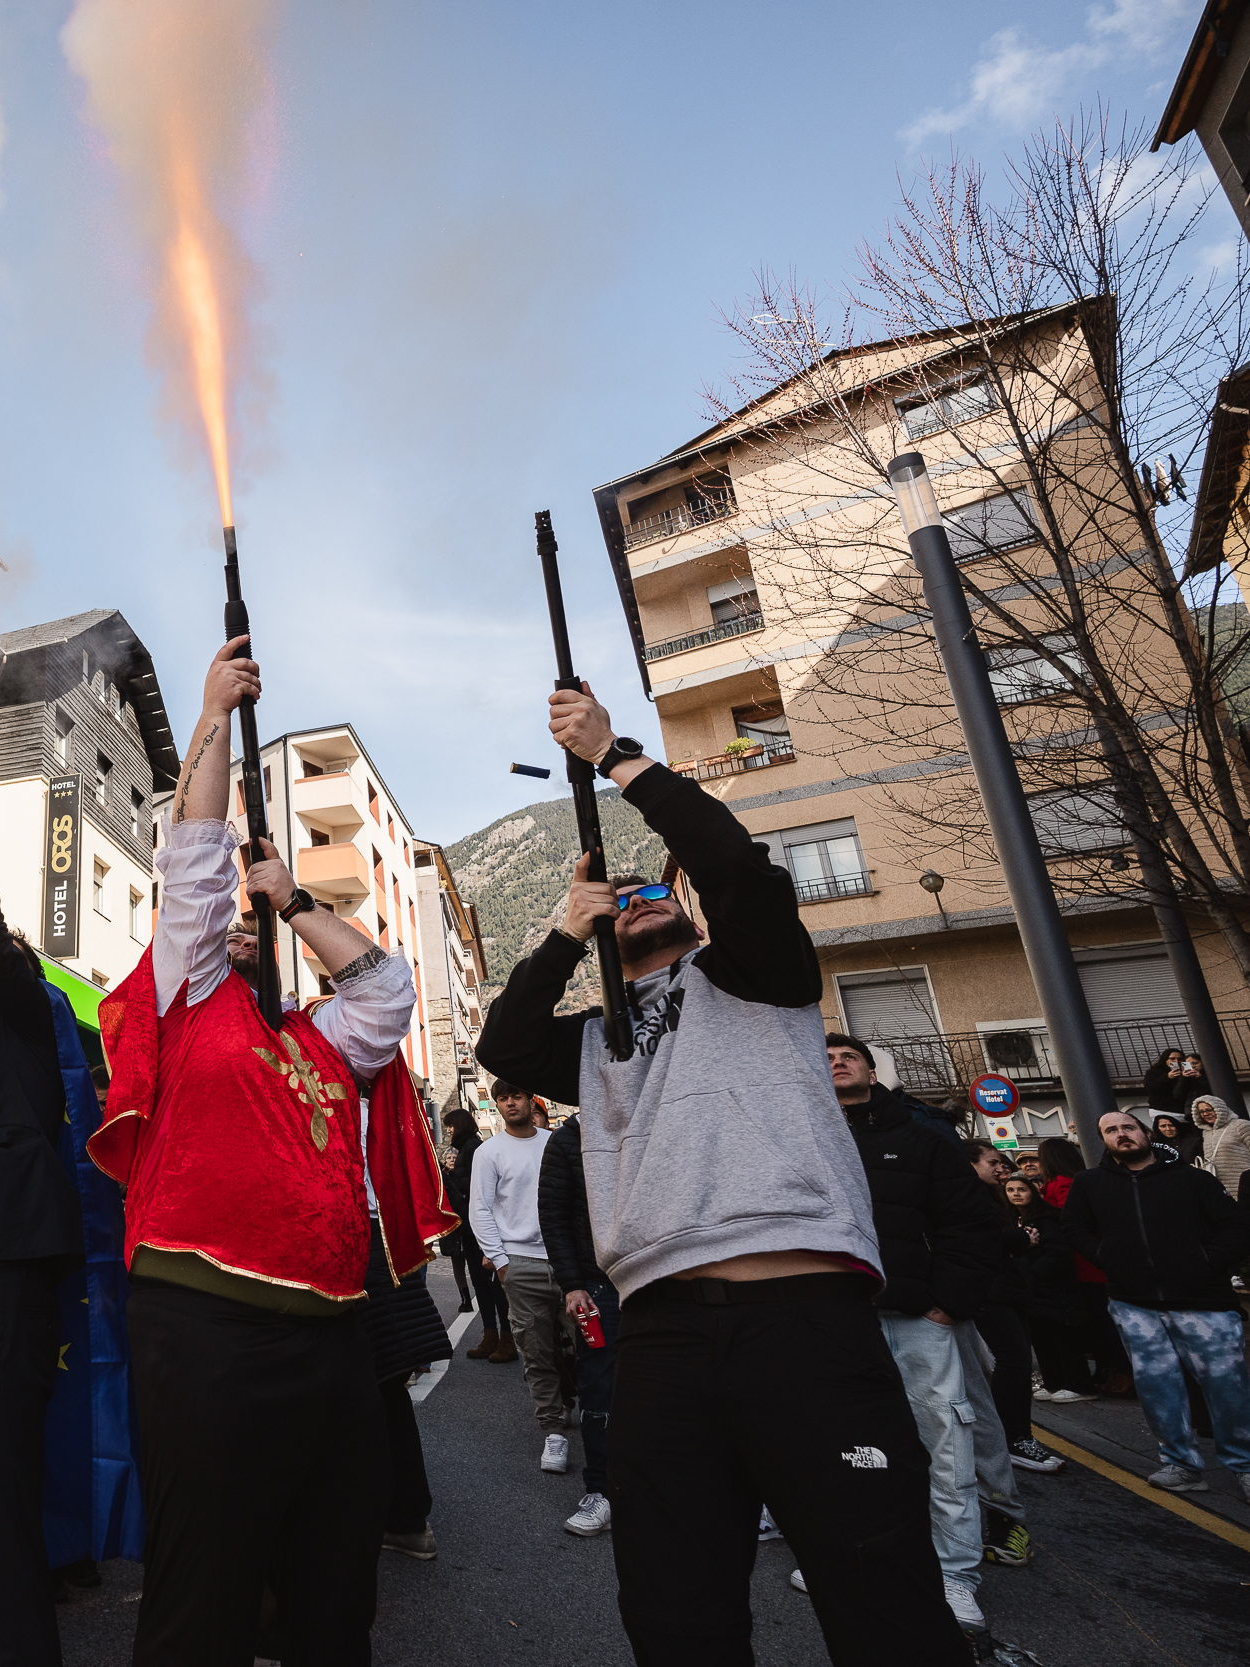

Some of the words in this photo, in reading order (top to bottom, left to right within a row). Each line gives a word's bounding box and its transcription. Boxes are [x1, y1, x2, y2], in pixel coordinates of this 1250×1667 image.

[51, 781, 76, 790] HOTEL
[51, 814, 73, 873] OROS
[53, 880, 68, 936] HOTEL
[854, 1446, 870, 1454] THE
[841, 1452, 872, 1460] NORTH
[852, 1460, 873, 1468] FACE
